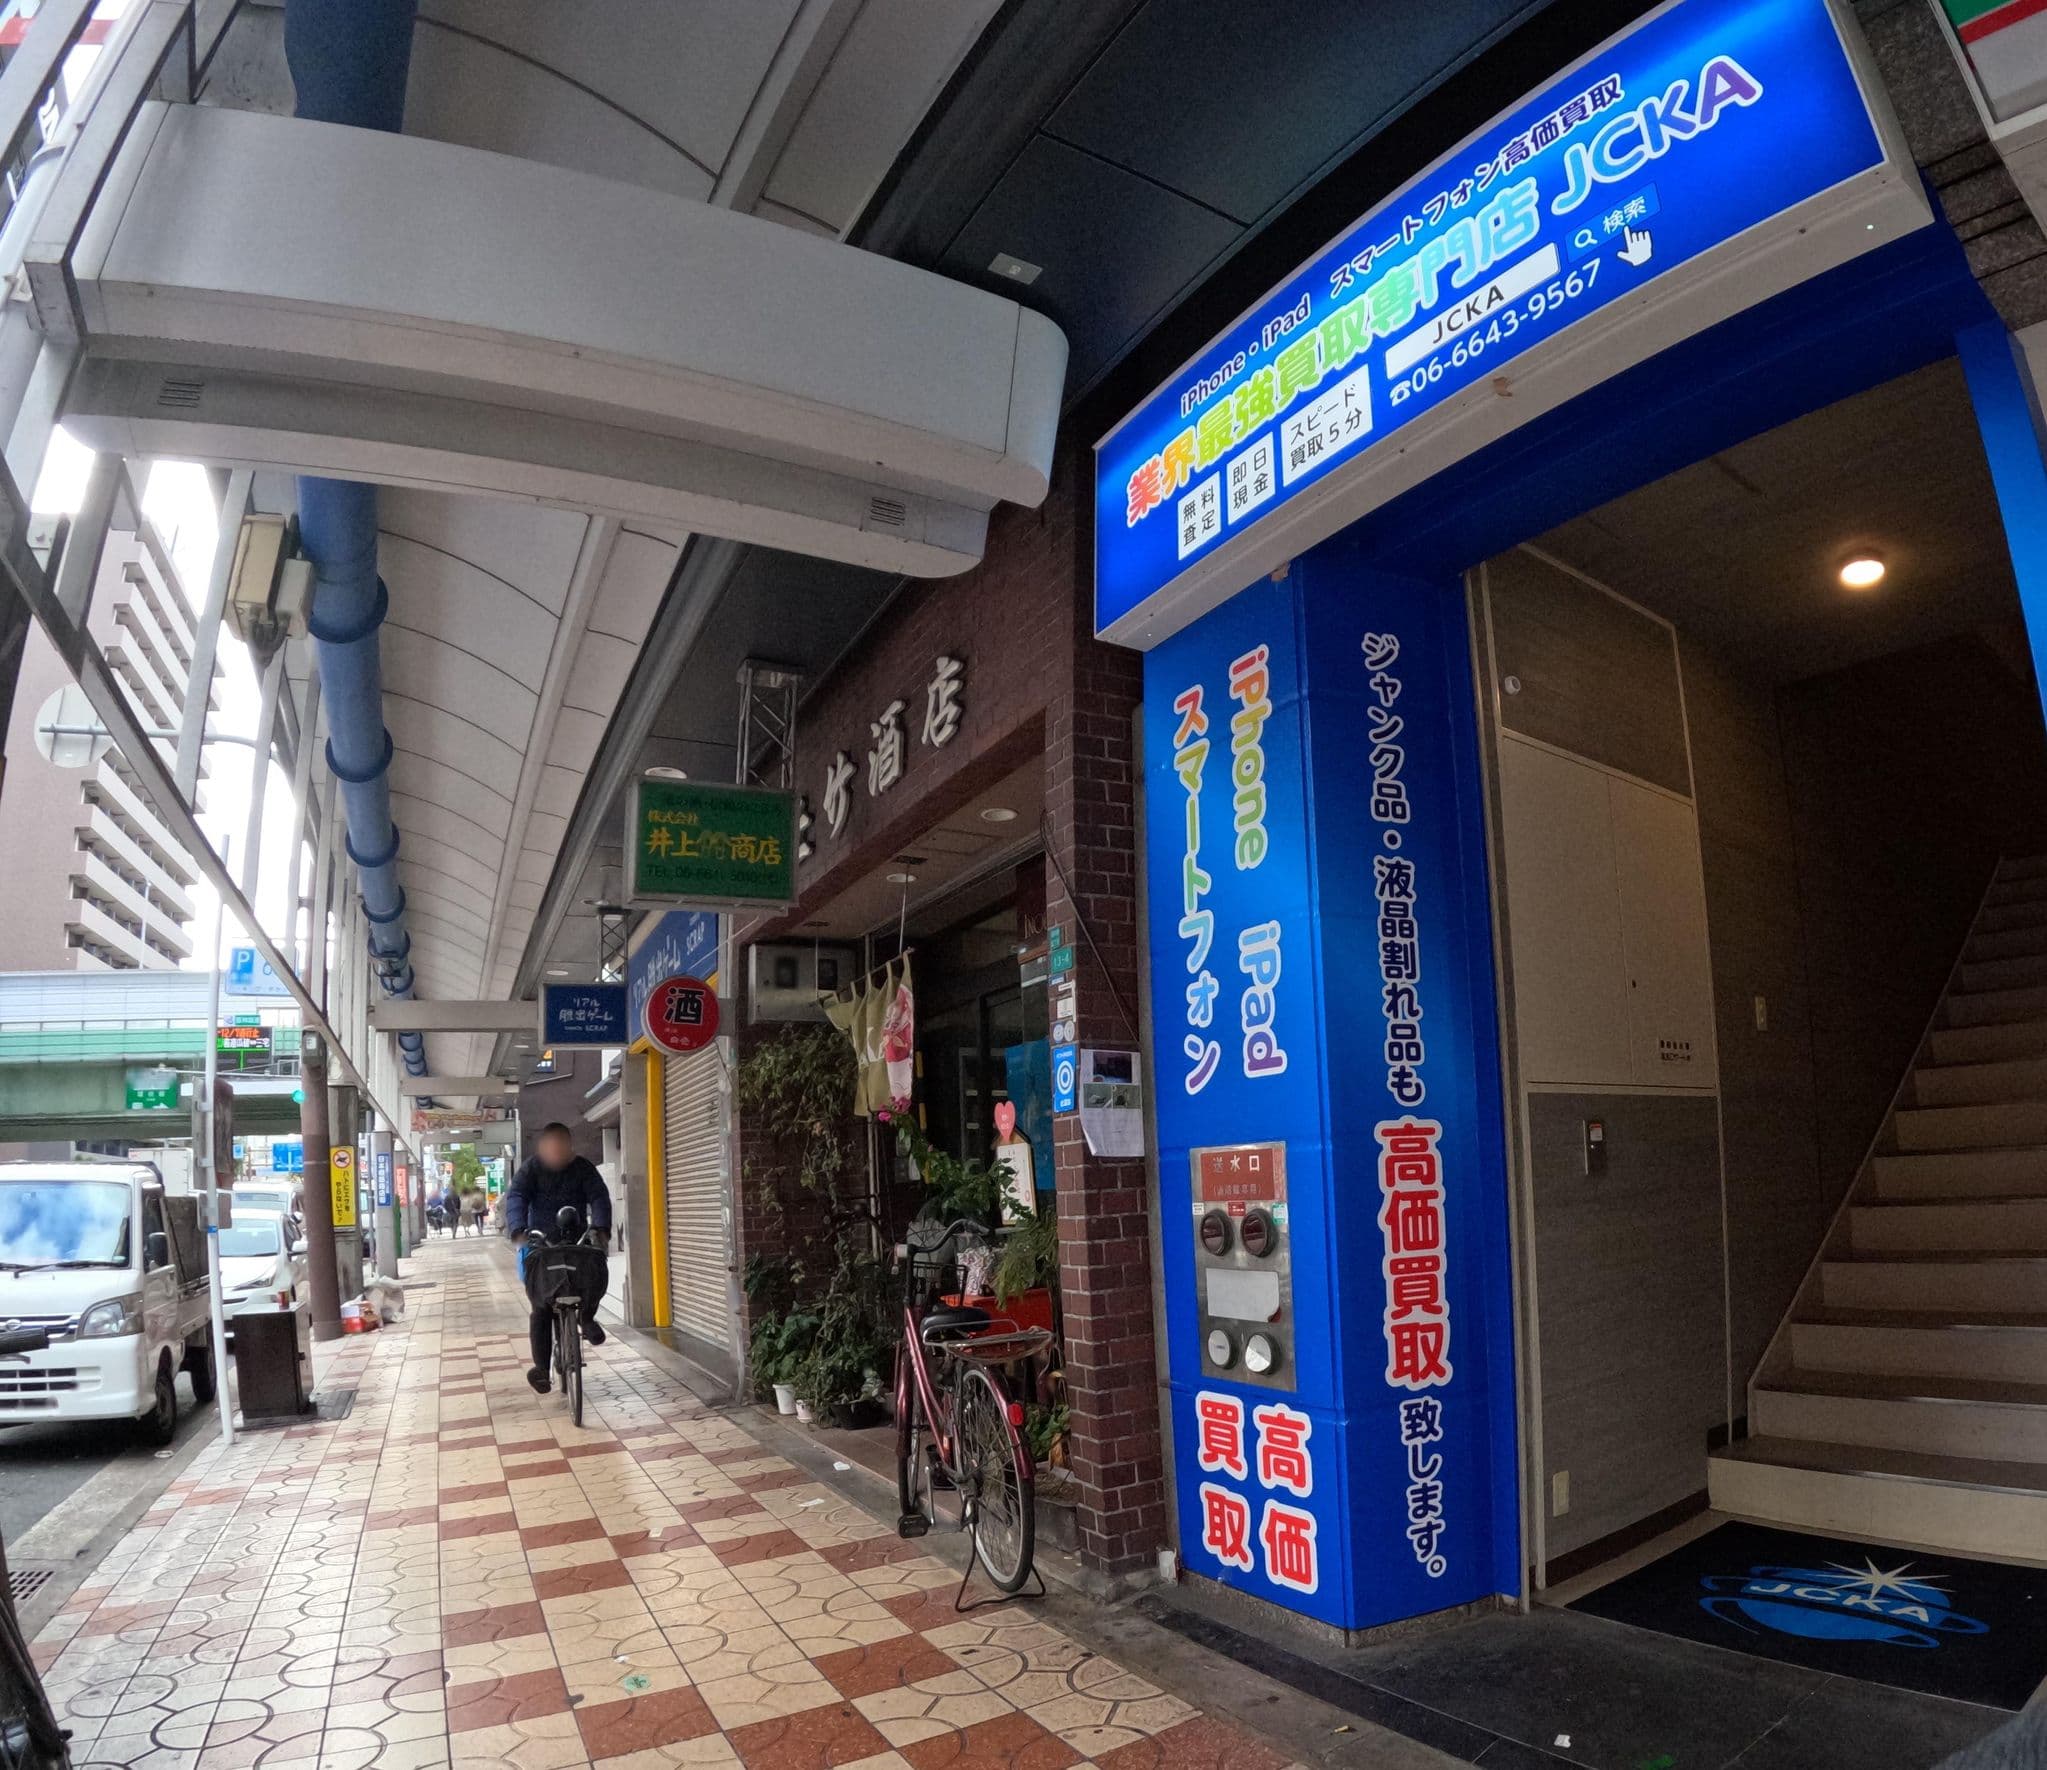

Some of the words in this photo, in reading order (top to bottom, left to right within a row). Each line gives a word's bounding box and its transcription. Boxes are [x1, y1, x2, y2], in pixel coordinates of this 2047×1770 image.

[1329, 73, 1624, 296] スマートフォン高価買取
[1603, 196, 1647, 234] 検索
[1125, 177, 1540, 528] 業界最強買取専門店
[1550, 54, 1763, 215] JCKA
[1432, 285, 1505, 344] JCKA
[1412, 258, 1602, 391] 06-6643-9567
[1290, 387, 1356, 445] スピード
[1233, 447, 1267, 484] 即日
[1233, 473, 1269, 510] 現金
[1183, 485, 1215, 521] 無料
[1183, 513, 1216, 546] 査定
[1230, 643, 1272, 871] iPhone
[1173, 684, 1220, 1094] スマートフォン
[559, 1007, 614, 1023] 脱出ゲーム
[572, 997, 601, 1009] リアル
[662, 987, 706, 1026] 酒
[1239, 920, 1288, 1078] iPad
[1212, 1154, 1261, 1174] 送水口
[1374, 1115, 1453, 1392] 高価買取
[1195, 1391, 1254, 1573] 買取
[1252, 1403, 1318, 1594] 高価
[1749, 1583, 1930, 1623] JCKA
